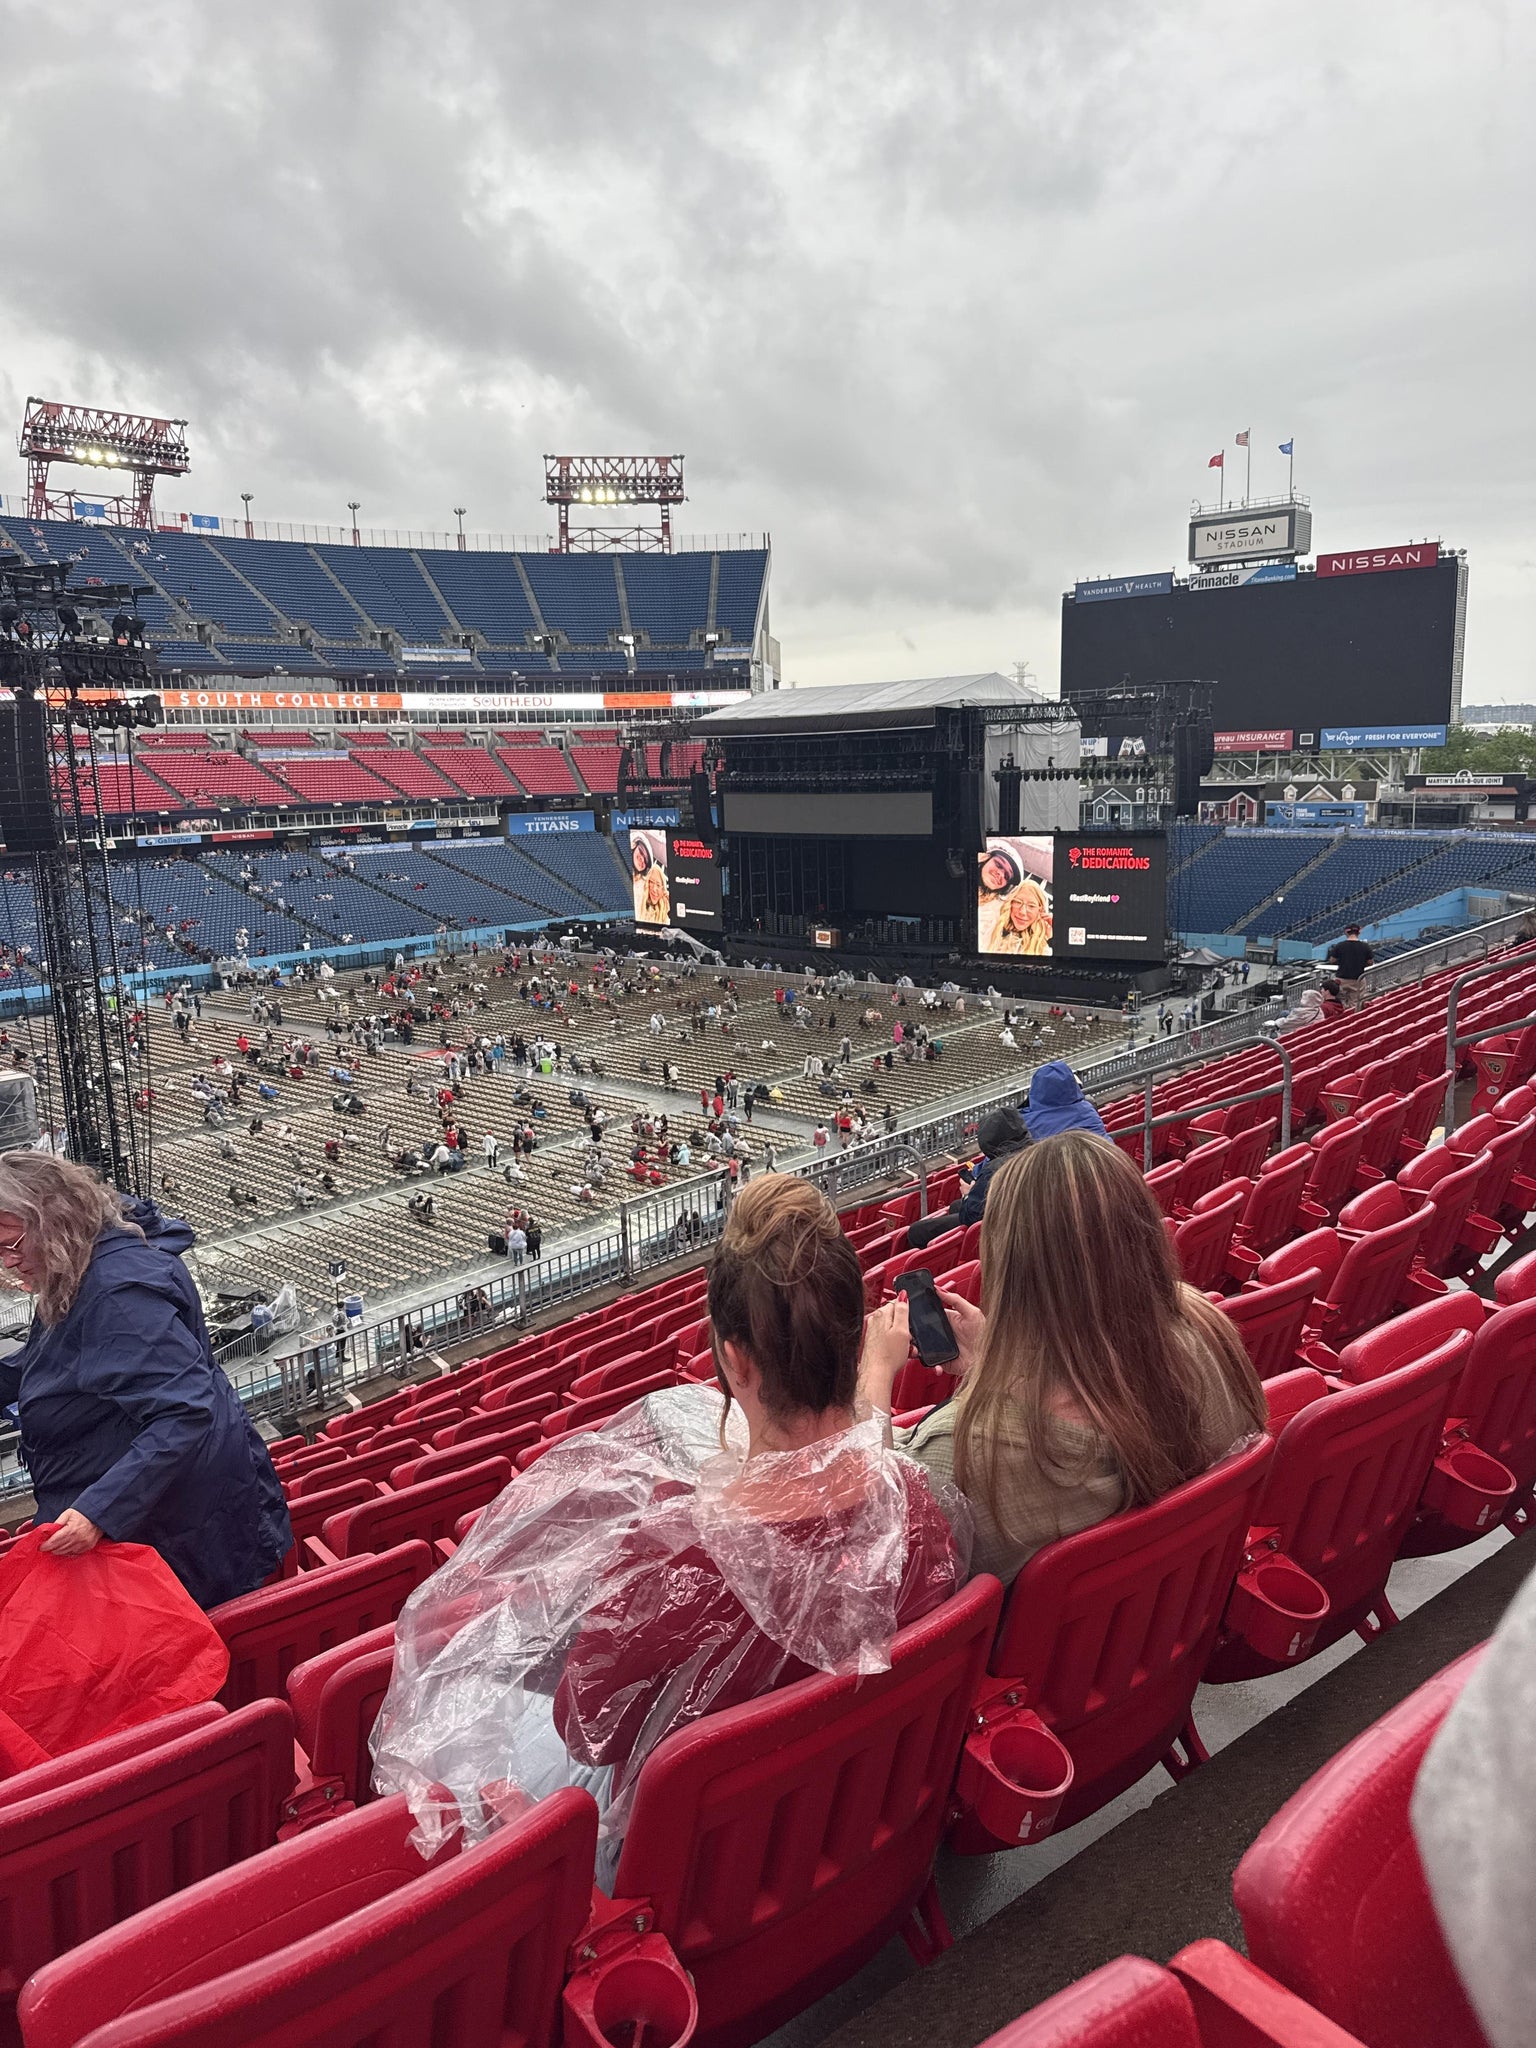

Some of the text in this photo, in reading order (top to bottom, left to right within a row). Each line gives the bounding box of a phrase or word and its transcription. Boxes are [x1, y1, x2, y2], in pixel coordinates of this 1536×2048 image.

[1206, 524, 1276, 542] NISSAN
[1217, 538, 1264, 550] STADIUM
[1331, 550, 1421, 571] NISSAN
[1190, 573, 1239, 589] Pinnacle
[1083, 585, 1123, 596] VANDERBILT
[1135, 582, 1162, 590] HEALTH
[179, 692, 379, 707] SOUTH COLLEGE
[473, 696, 553, 707] SOUTH.EDU
[1214, 732, 1286, 743] ureau INSURANCE
[1336, 731, 1362, 745] Kroger
[616, 815, 676, 825] NISSAN
[524, 820, 580, 832] TITANS
[157, 836, 192, 845] Gallagher
[680, 848, 713, 858] DEDICATIONS
[1082, 847, 1133, 856] THE ROMANTIC
[1082, 857, 1150, 869] DEDICATIONS
[1069, 893, 1110, 903] #BestBoyfriend
[130, 977, 166, 988] TENNESSEE
[338, 1265, 343, 1273] F
